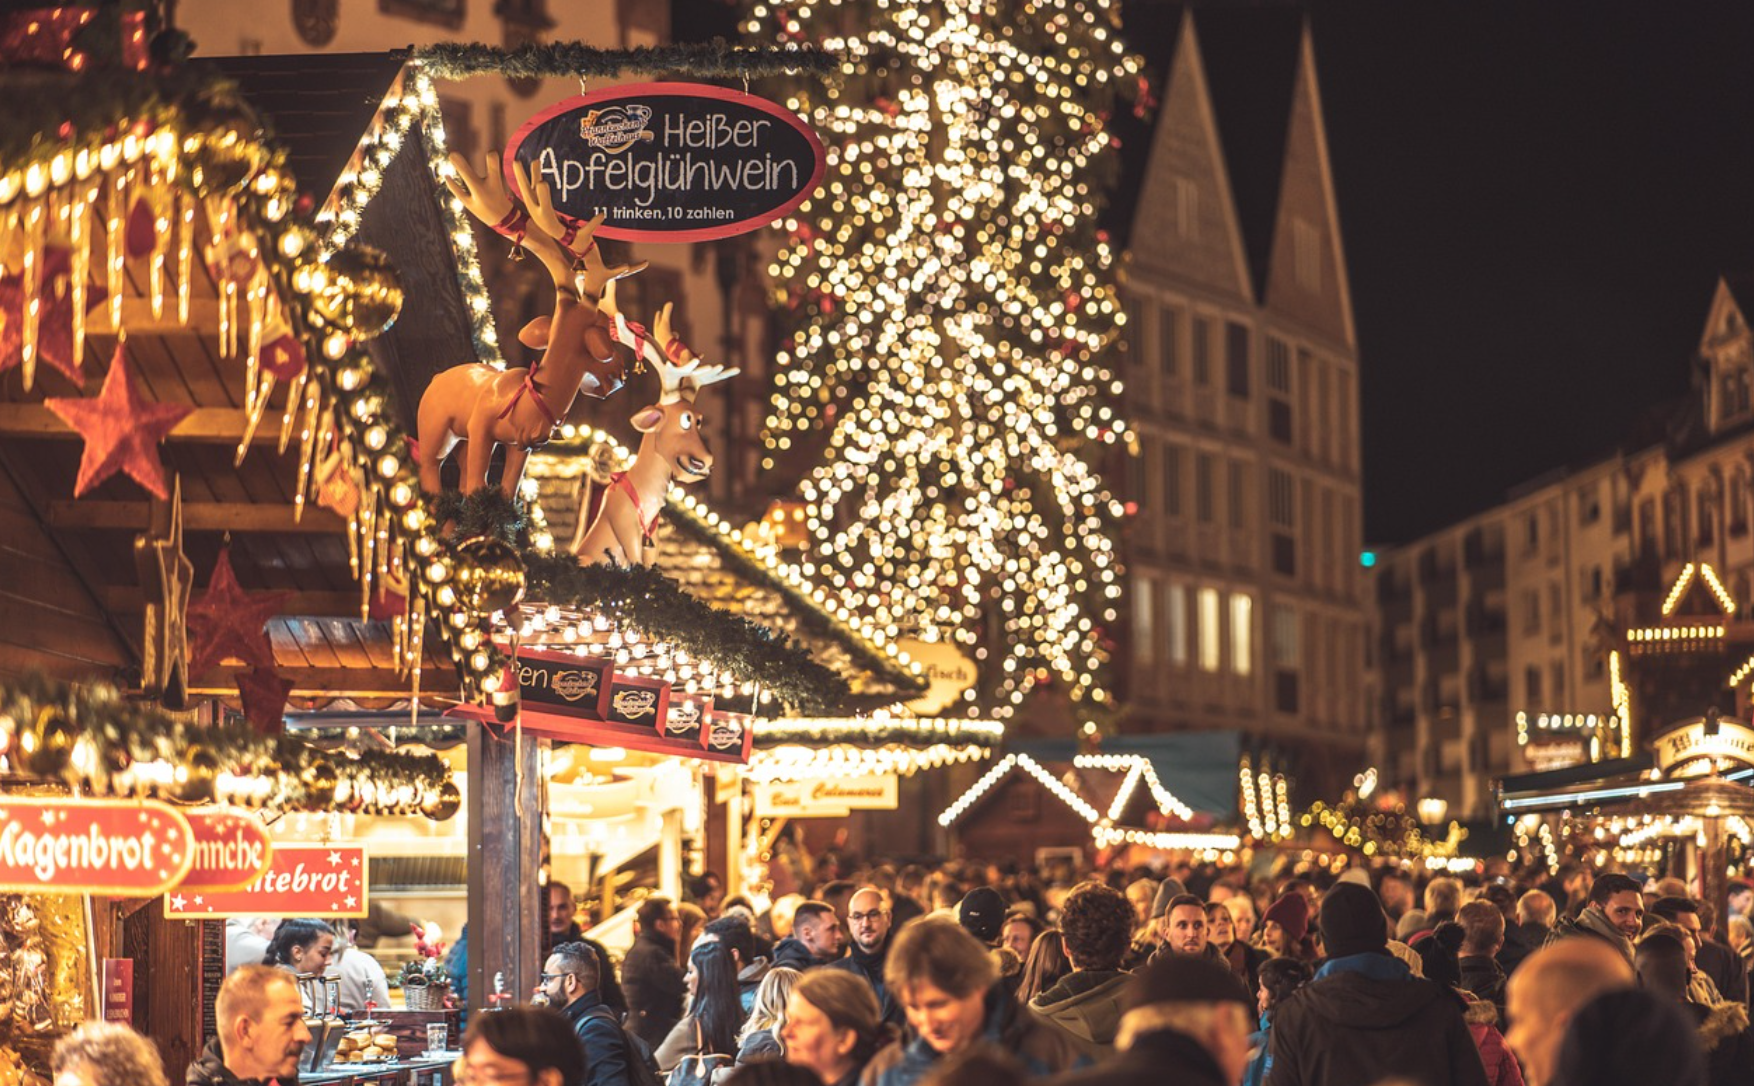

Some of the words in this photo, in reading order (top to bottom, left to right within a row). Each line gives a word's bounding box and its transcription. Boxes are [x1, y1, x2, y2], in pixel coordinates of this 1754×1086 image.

[663, 113, 771, 149] Heißer
[539, 148, 798, 206] Apfelglühwein
[593, 207, 608, 219] 11
[687, 206, 734, 219] zahlen
[511, 660, 548, 688] en
